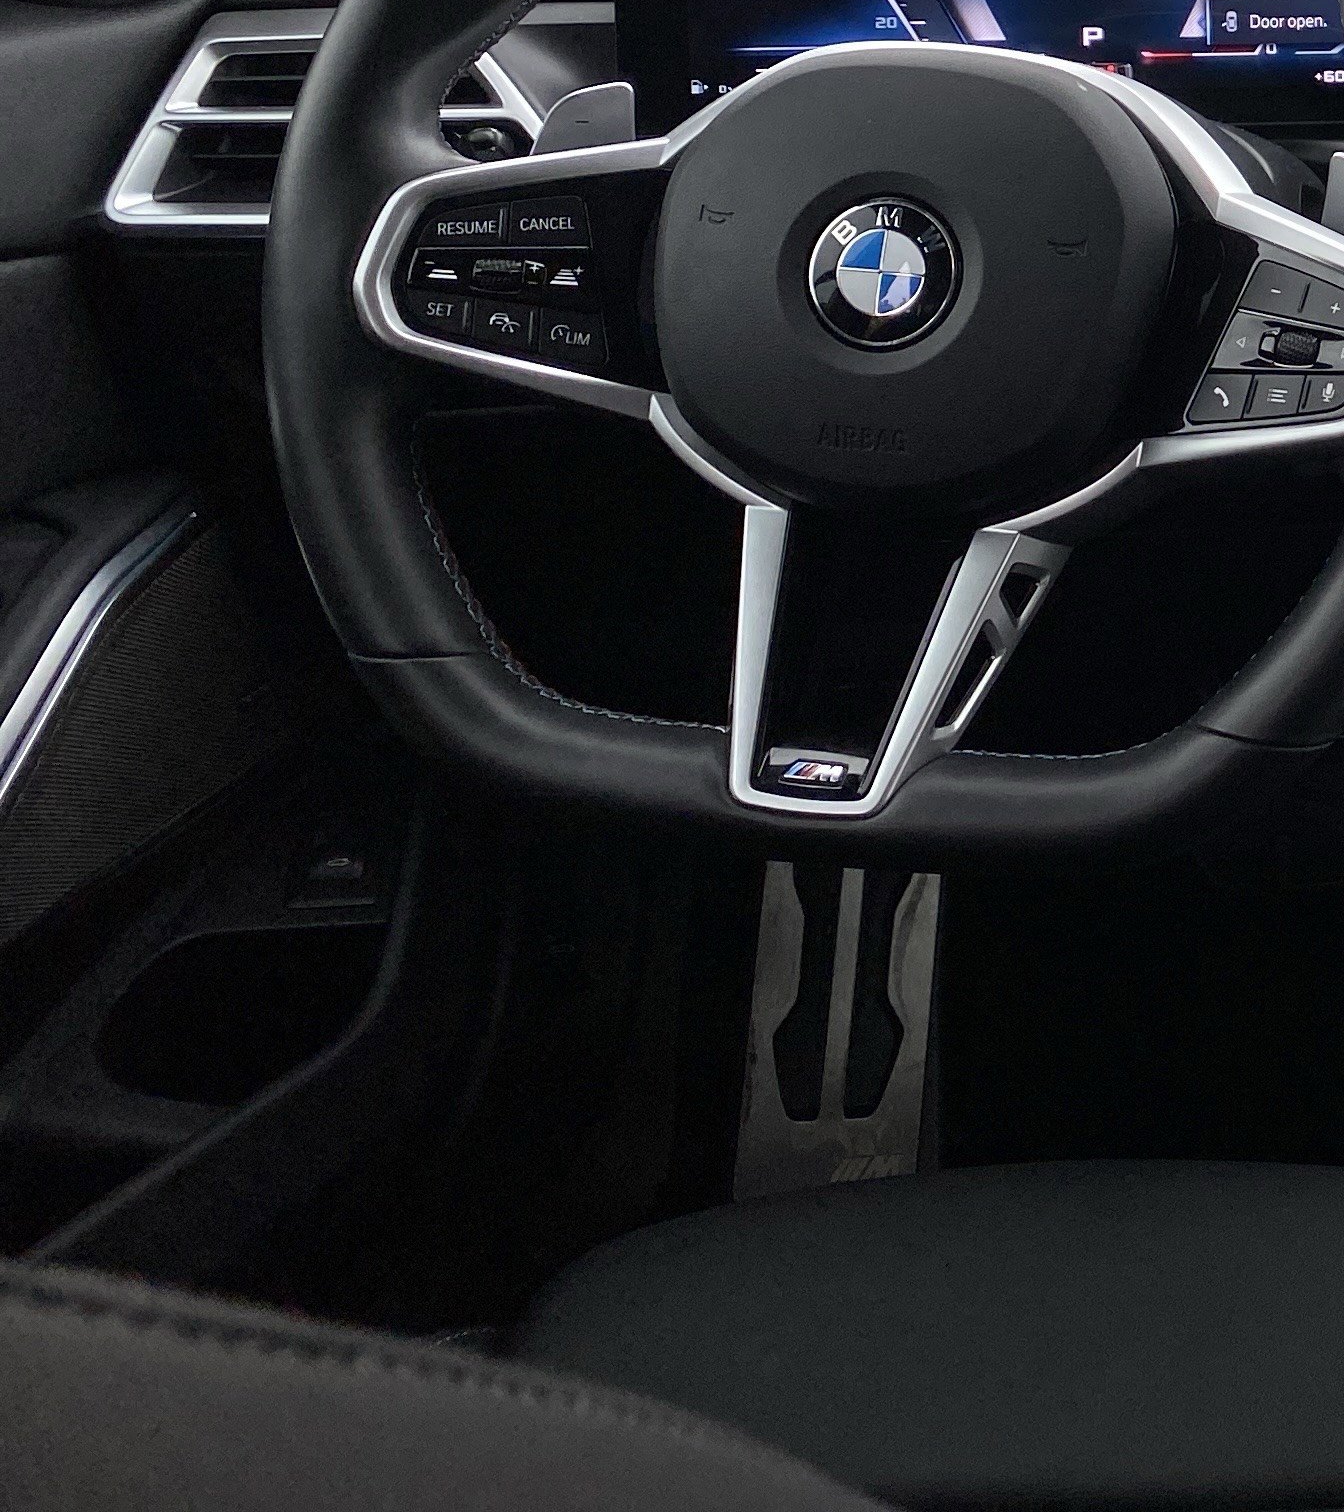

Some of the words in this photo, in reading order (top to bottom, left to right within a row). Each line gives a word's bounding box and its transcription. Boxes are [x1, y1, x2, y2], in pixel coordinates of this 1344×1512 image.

[875, 17, 898, 30] 20
[1249, 14, 1284, 29] Door
[1287, 15, 1328, 31] open.
[1082, 26, 1104, 47] P
[437, 219, 498, 236] RESUME
[519, 217, 575, 232] CANCEL
[831, 206, 946, 255] BMW
[427, 302, 454, 317] SET
[565, 330, 591, 346] LIM
